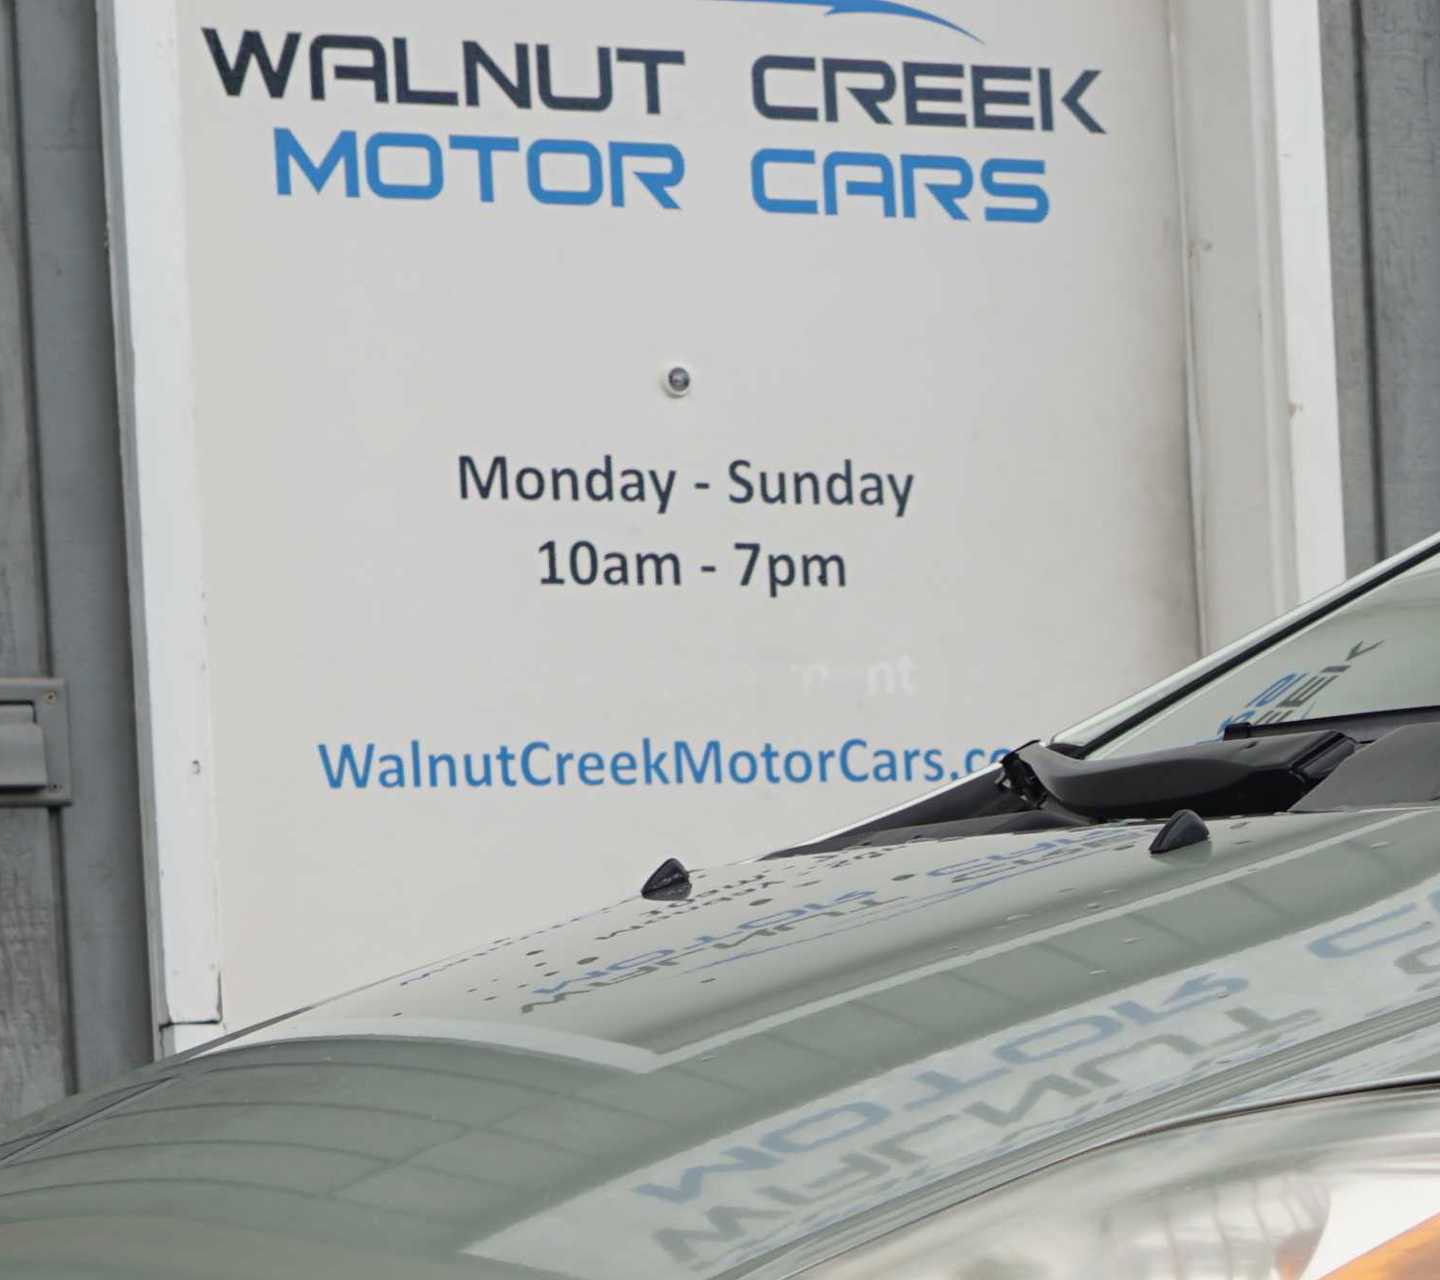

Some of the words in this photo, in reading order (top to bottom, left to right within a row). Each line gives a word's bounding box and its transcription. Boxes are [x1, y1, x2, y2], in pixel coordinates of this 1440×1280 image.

[202, 27, 686, 116] WALNUT
[750, 55, 1107, 136] CREEK
[273, 126, 687, 211] MOTOR
[749, 147, 1051, 224] CARS
[457, 454, 678, 514] Monday
[727, 458, 915, 519] Sunday
[538, 541, 682, 587] 10am
[734, 543, 848, 598] 7pm
